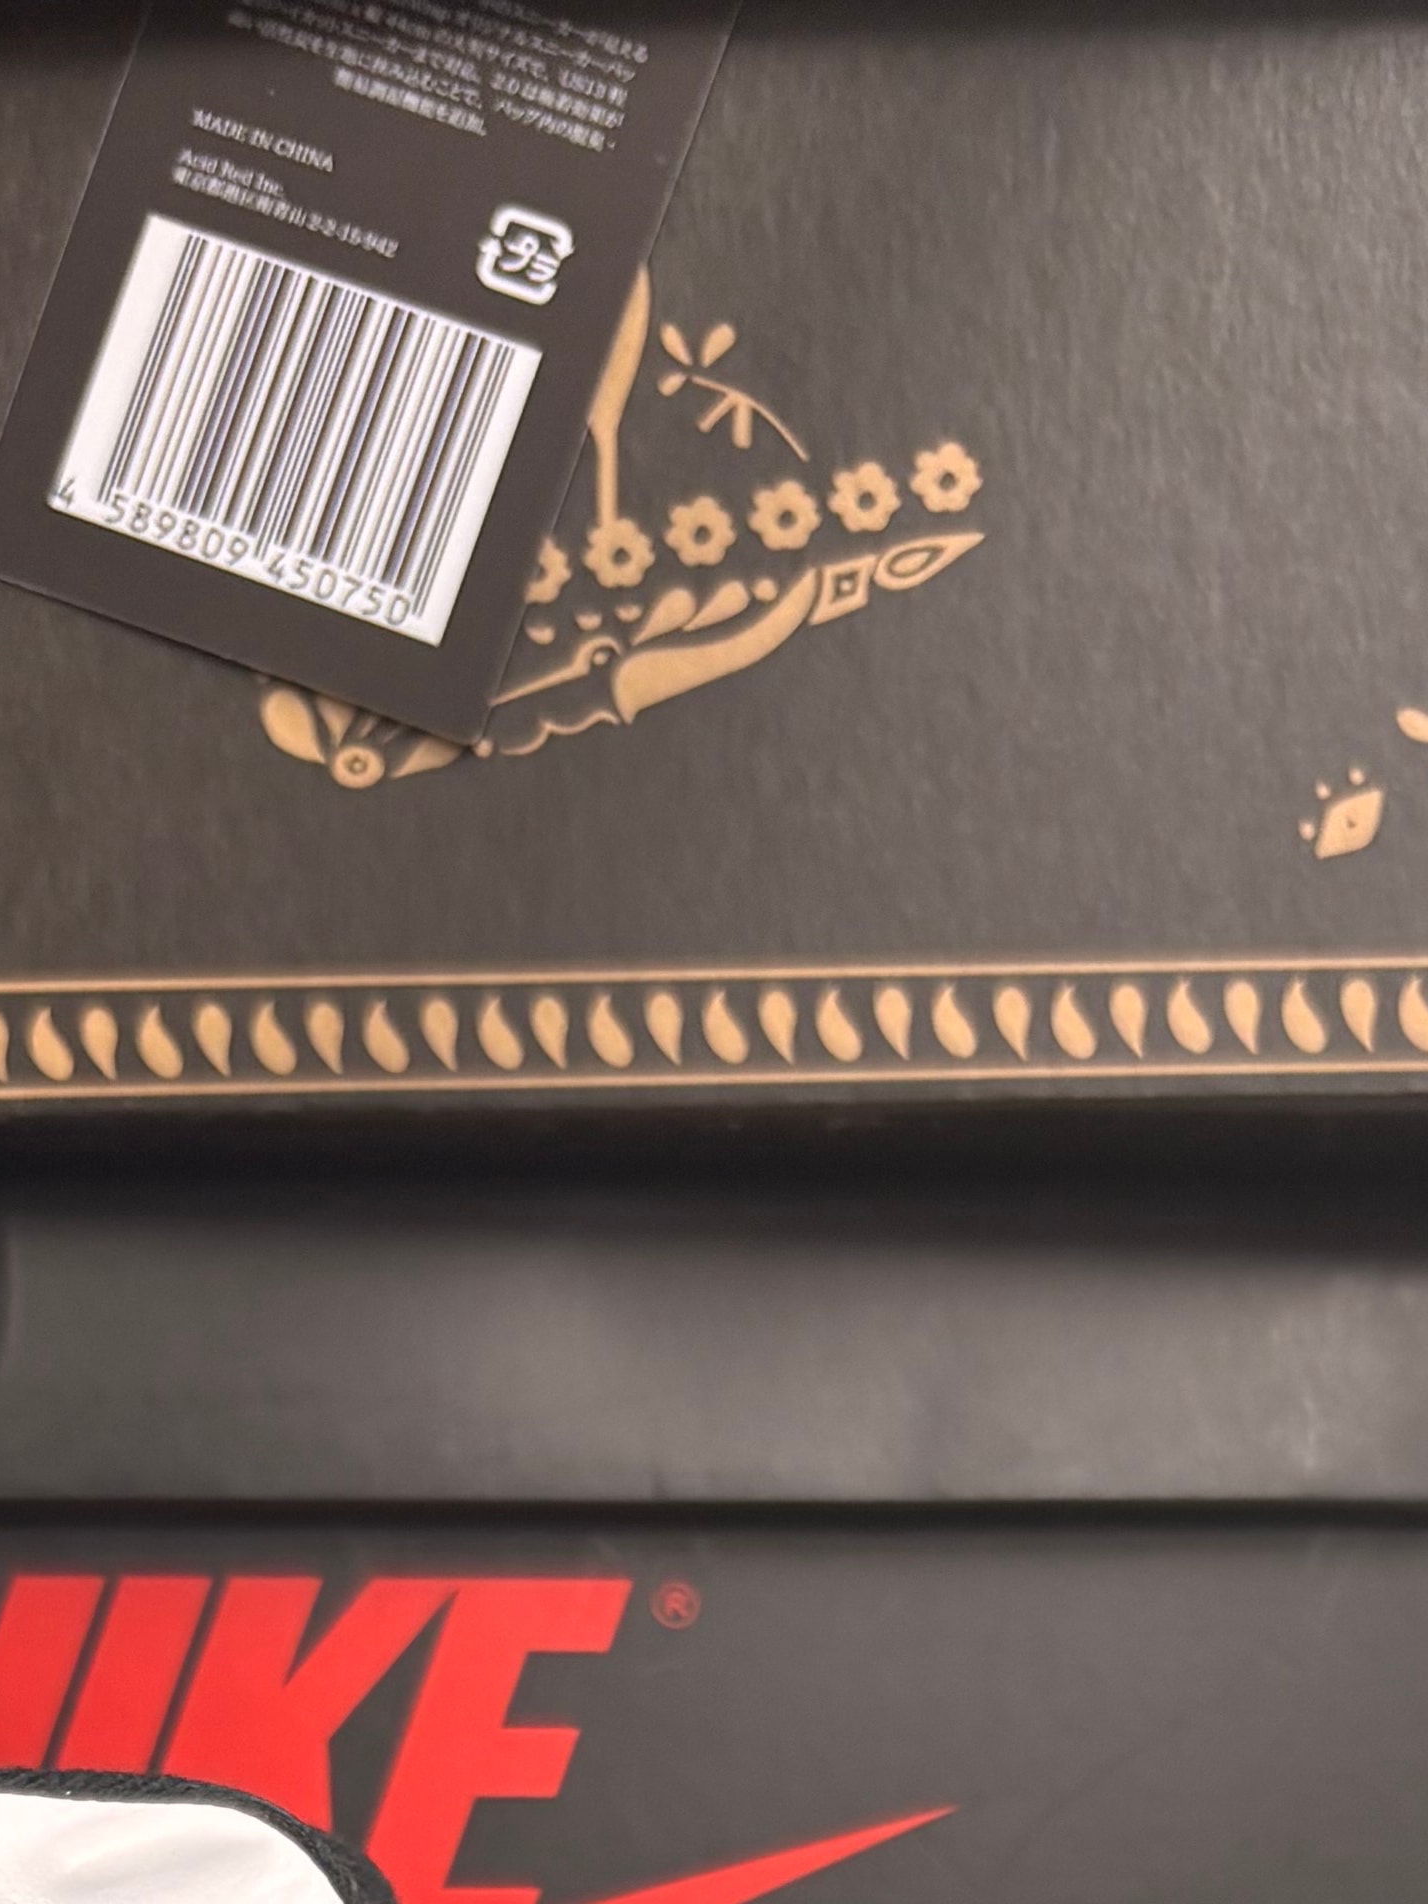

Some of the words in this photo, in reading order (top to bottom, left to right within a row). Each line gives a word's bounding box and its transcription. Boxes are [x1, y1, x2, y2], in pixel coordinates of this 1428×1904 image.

[192, 108, 247, 144] MADE
[250, 127, 274, 151] IN
[275, 138, 335, 173] CHINA
[105, 493, 250, 567] 589809
[264, 547, 413, 627] 450750
